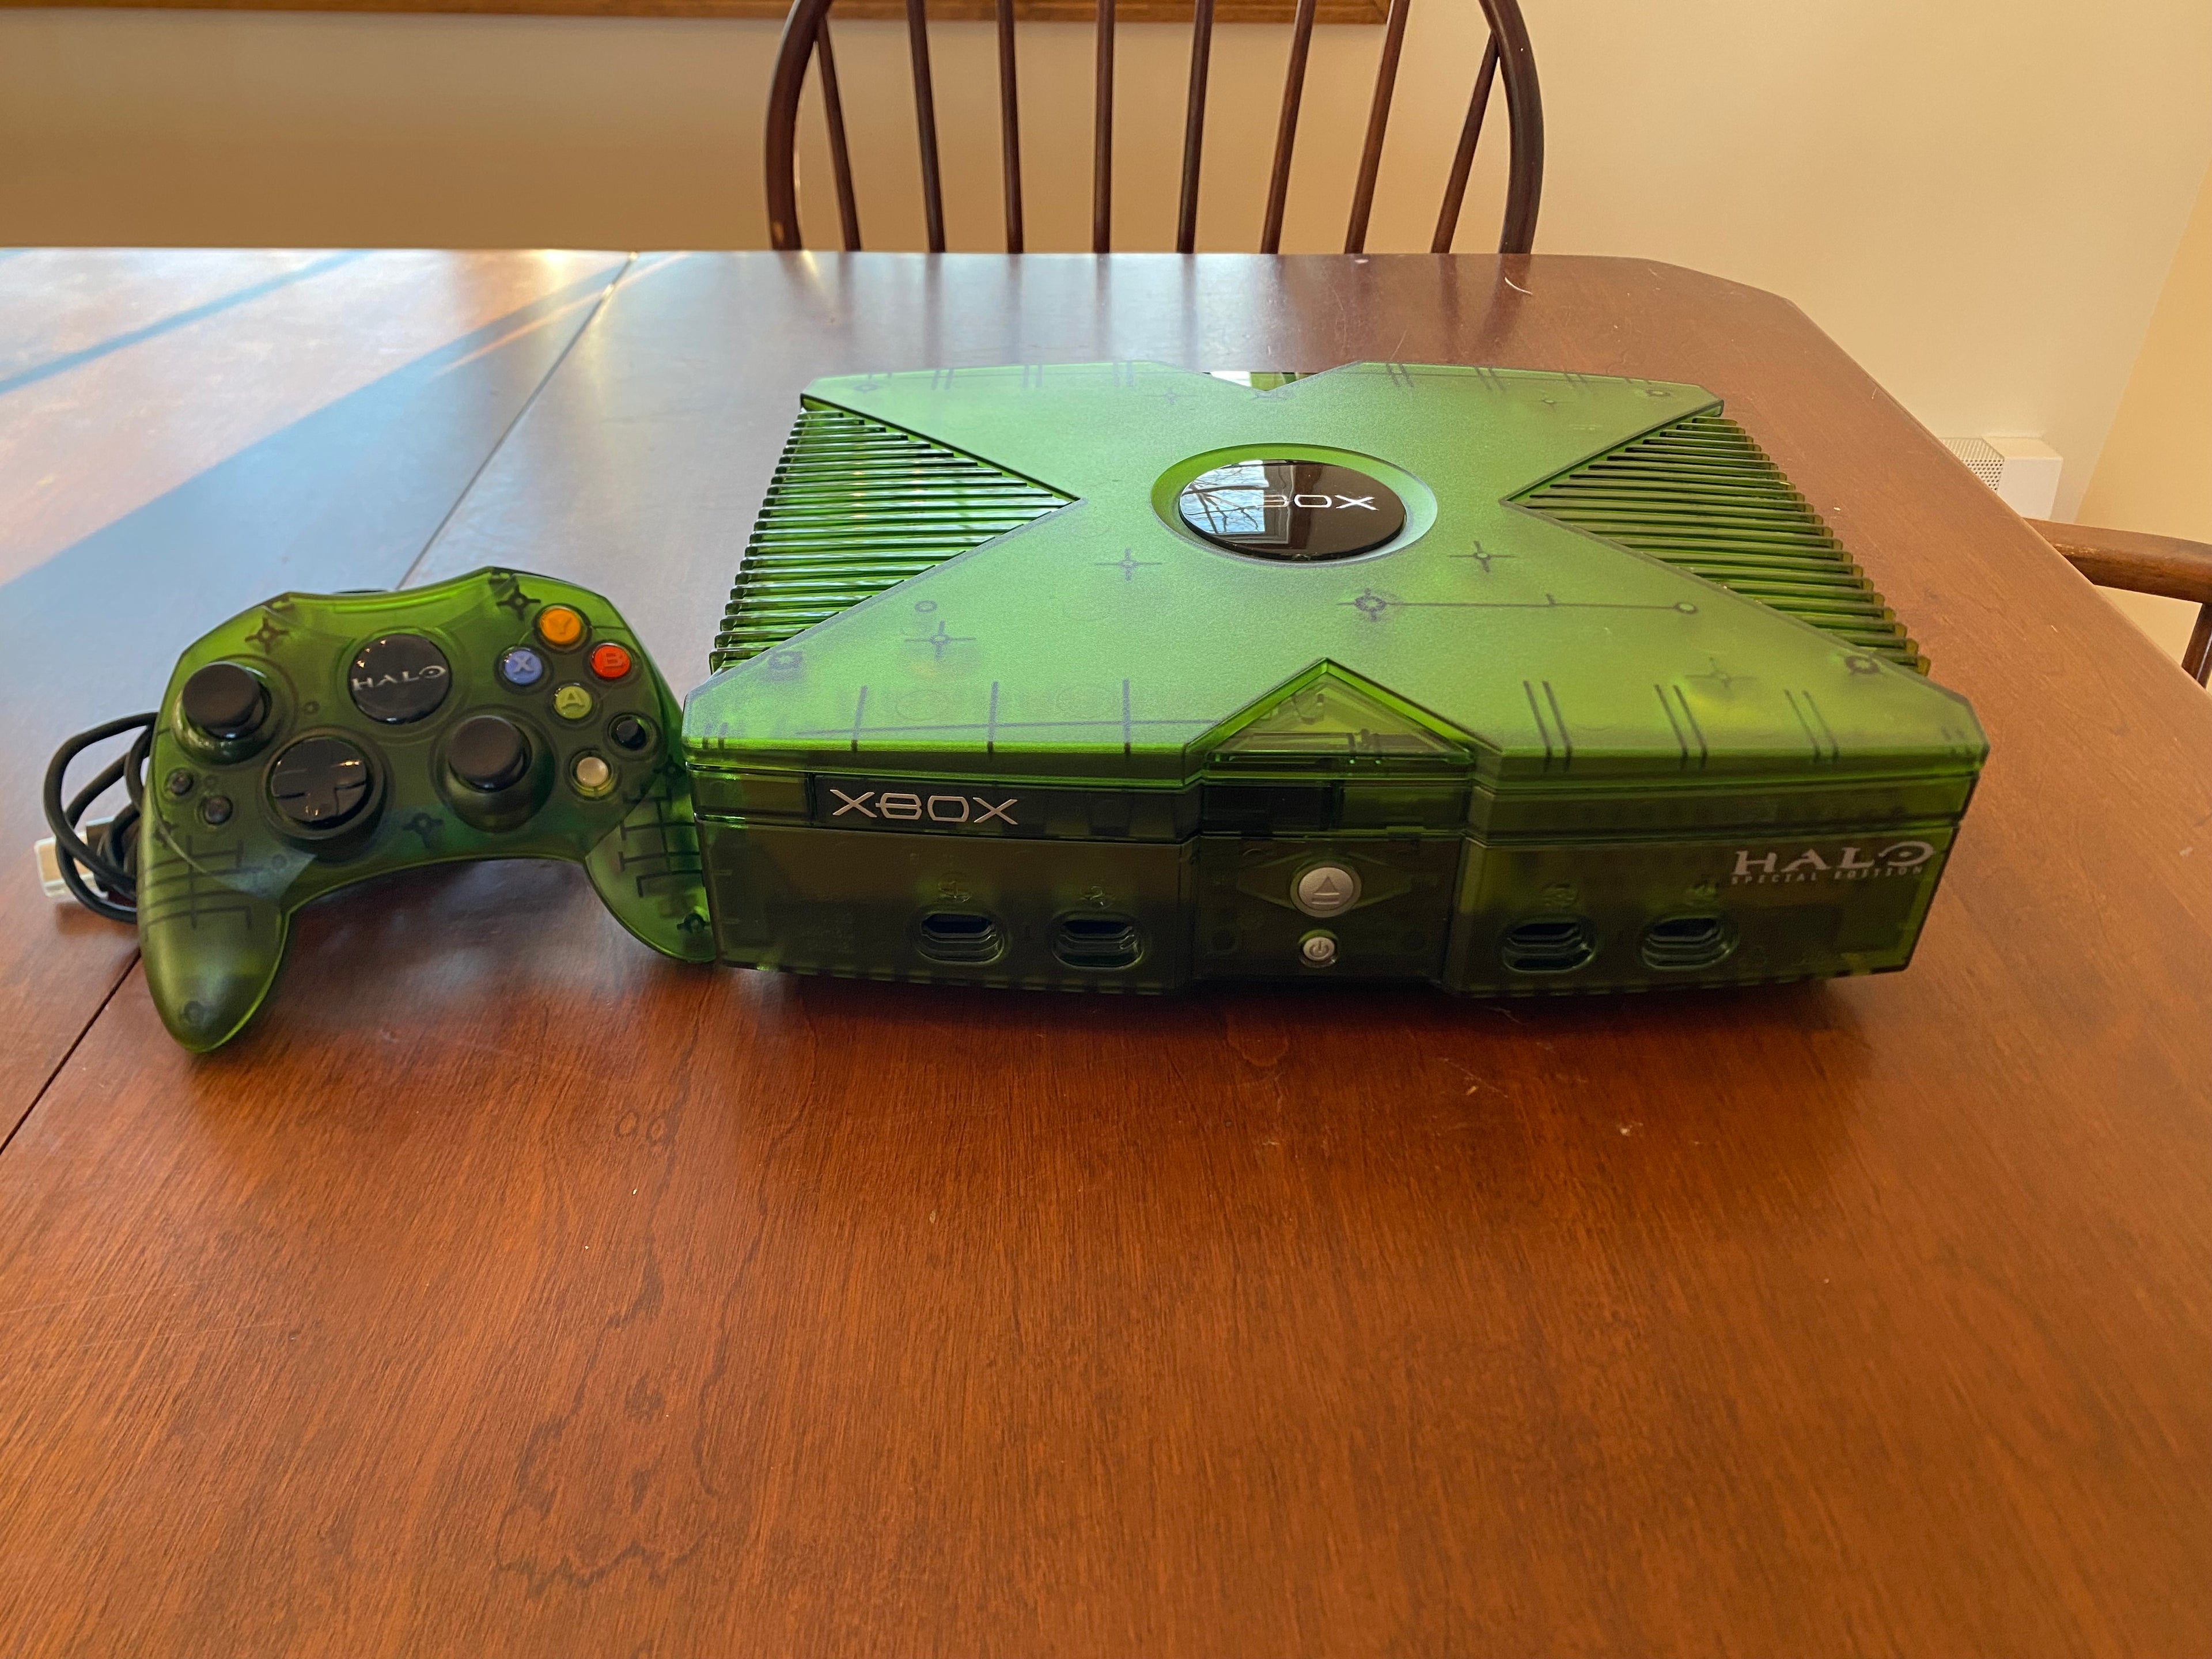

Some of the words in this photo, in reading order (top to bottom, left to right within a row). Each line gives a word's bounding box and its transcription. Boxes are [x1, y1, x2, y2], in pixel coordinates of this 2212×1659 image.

[548, 617, 573, 635] Y
[513, 654, 533, 674] X
[603, 652, 623, 668] B
[351, 665, 446, 691] HALO
[561, 692, 585, 709] A
[830, 789, 1018, 825] XBOX
[1732, 840, 1936, 876] HALO
[1731, 872, 1817, 885] SPECIAL
[1834, 865, 1923, 880] EDITION
